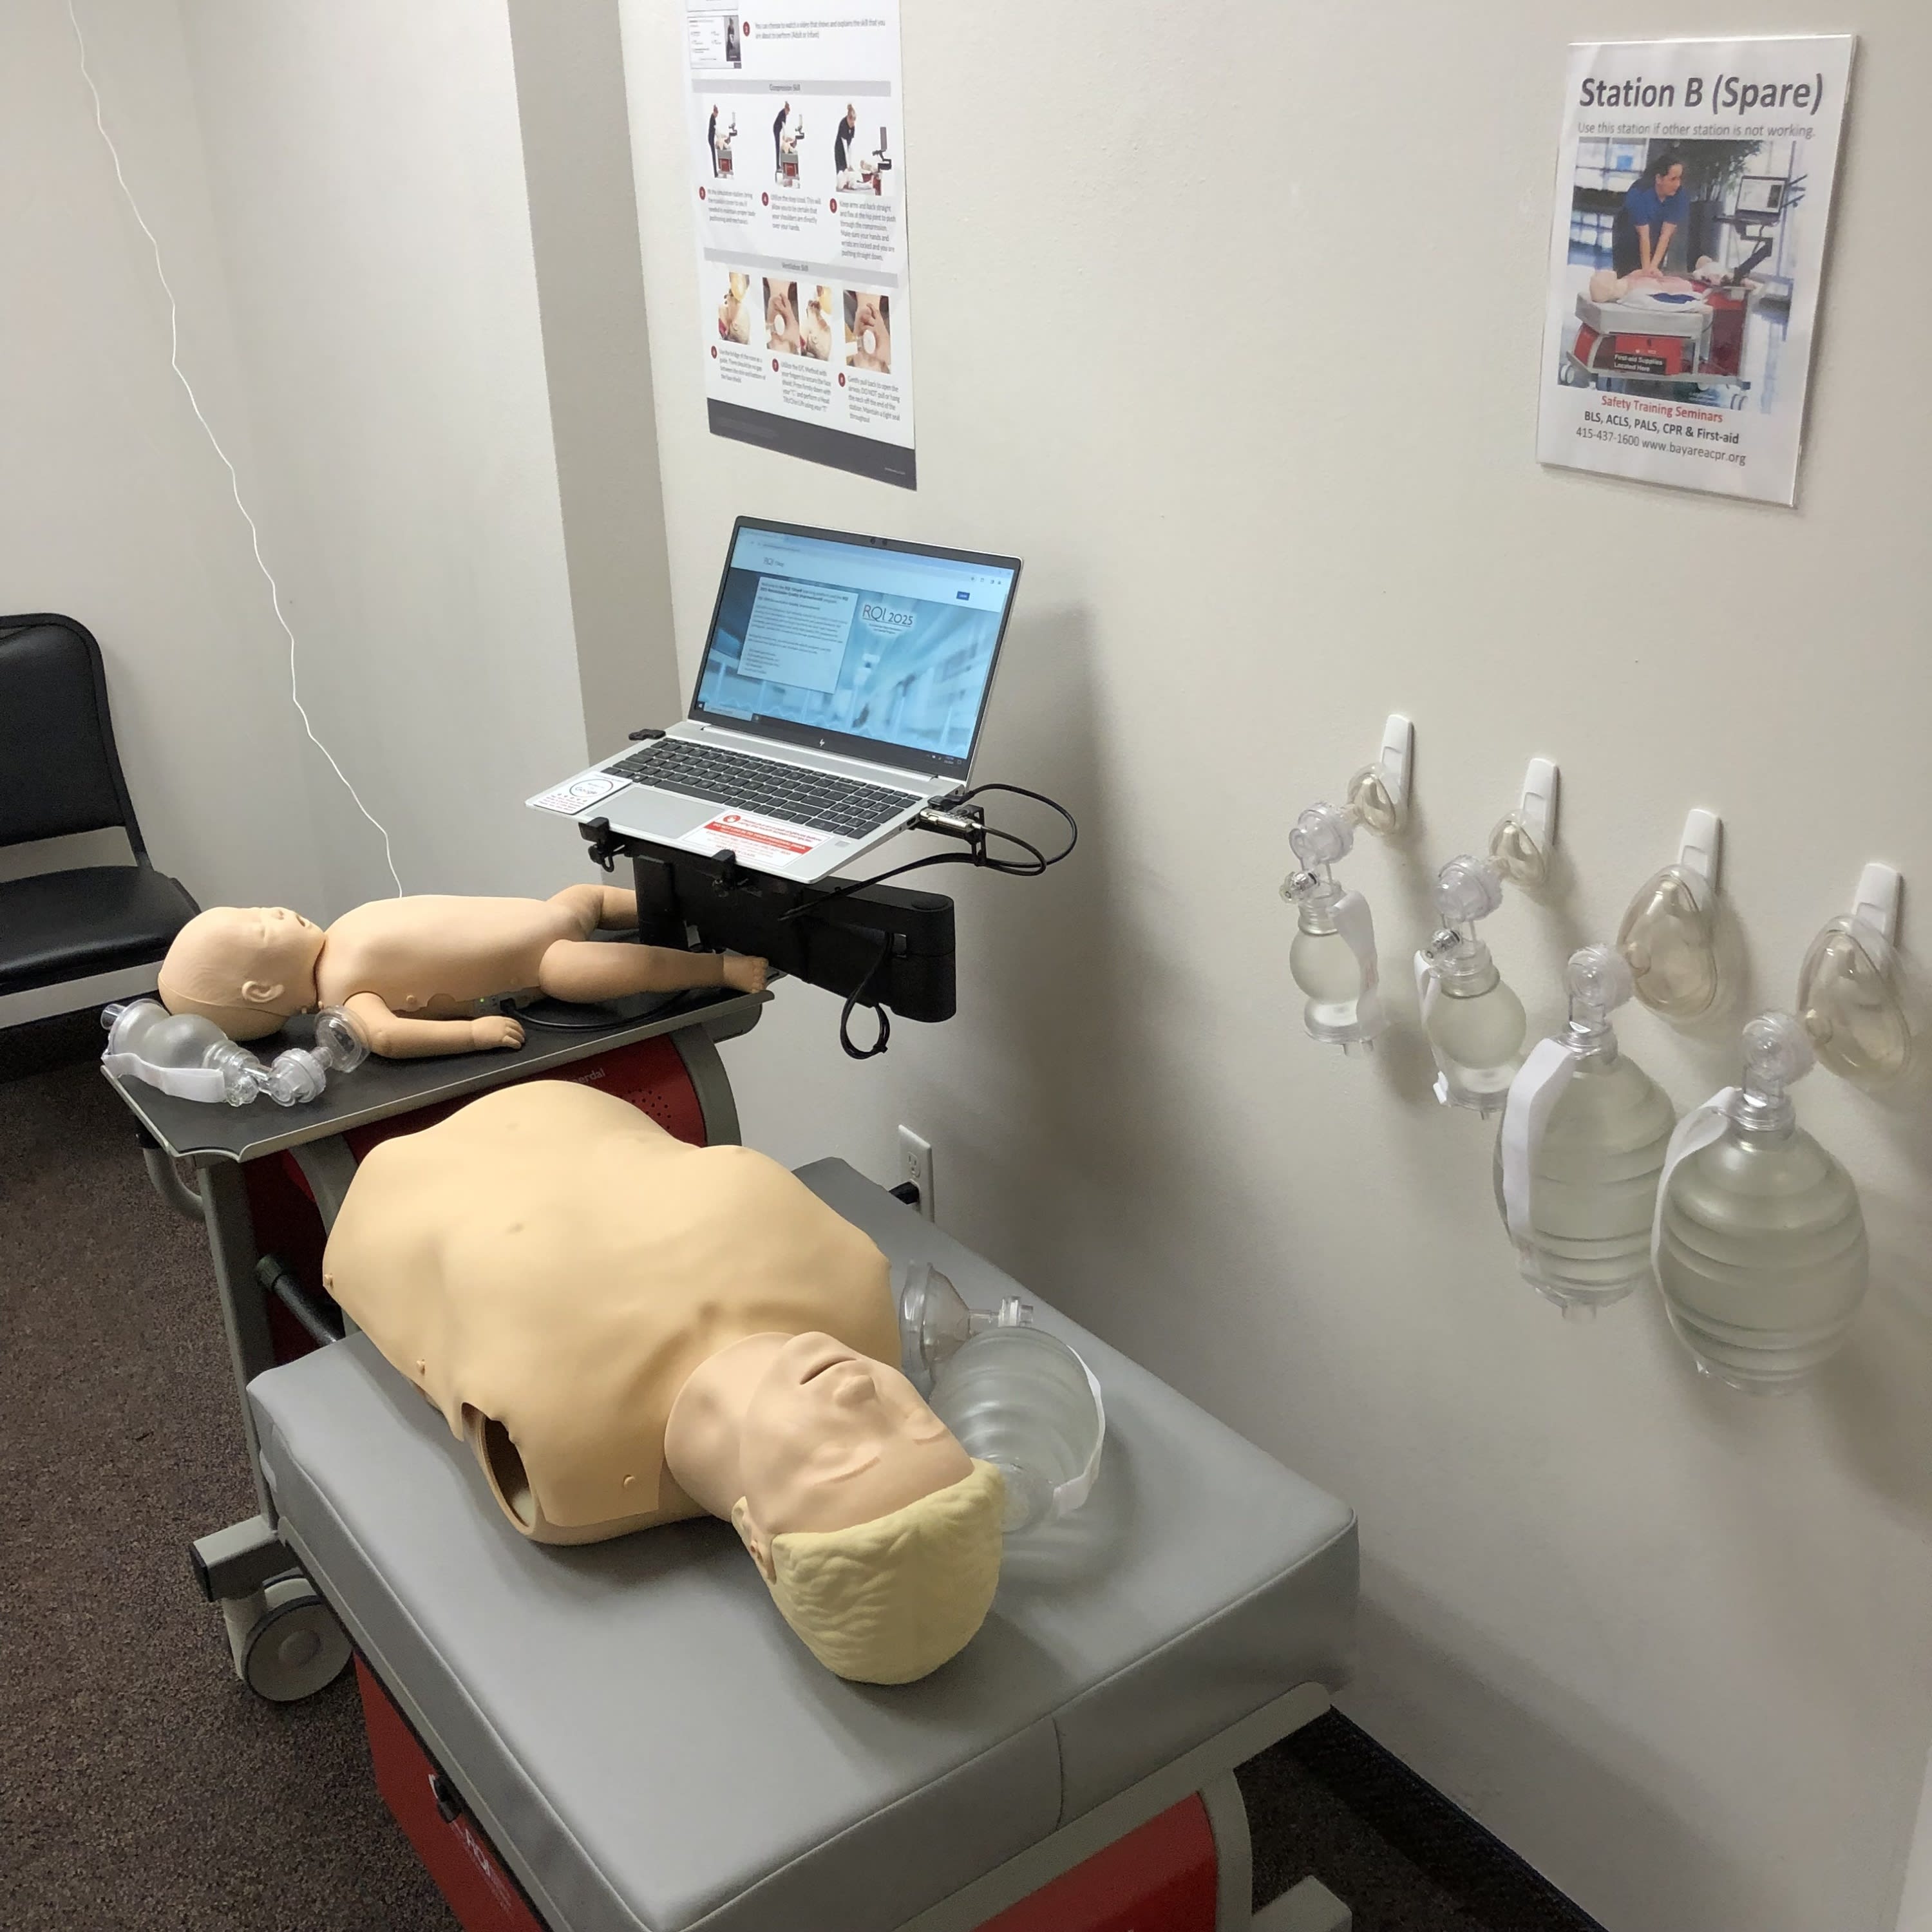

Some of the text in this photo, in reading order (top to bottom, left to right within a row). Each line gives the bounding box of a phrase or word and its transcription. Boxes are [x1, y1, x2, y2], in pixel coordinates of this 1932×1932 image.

[1580, 73, 1823, 115] Station B (Spare)
[1578, 122, 1815, 140] Use this station if other station is not working.
[1602, 395, 1723, 423] Safety Training Seminars
[1584, 411, 1739, 444] BLS, ACLS, PALS, CPR & First-aid
[1577, 426, 1747, 466] 415-437-1600 www.bayareacpr.org
[862, 604, 913, 625] RQI 2025
